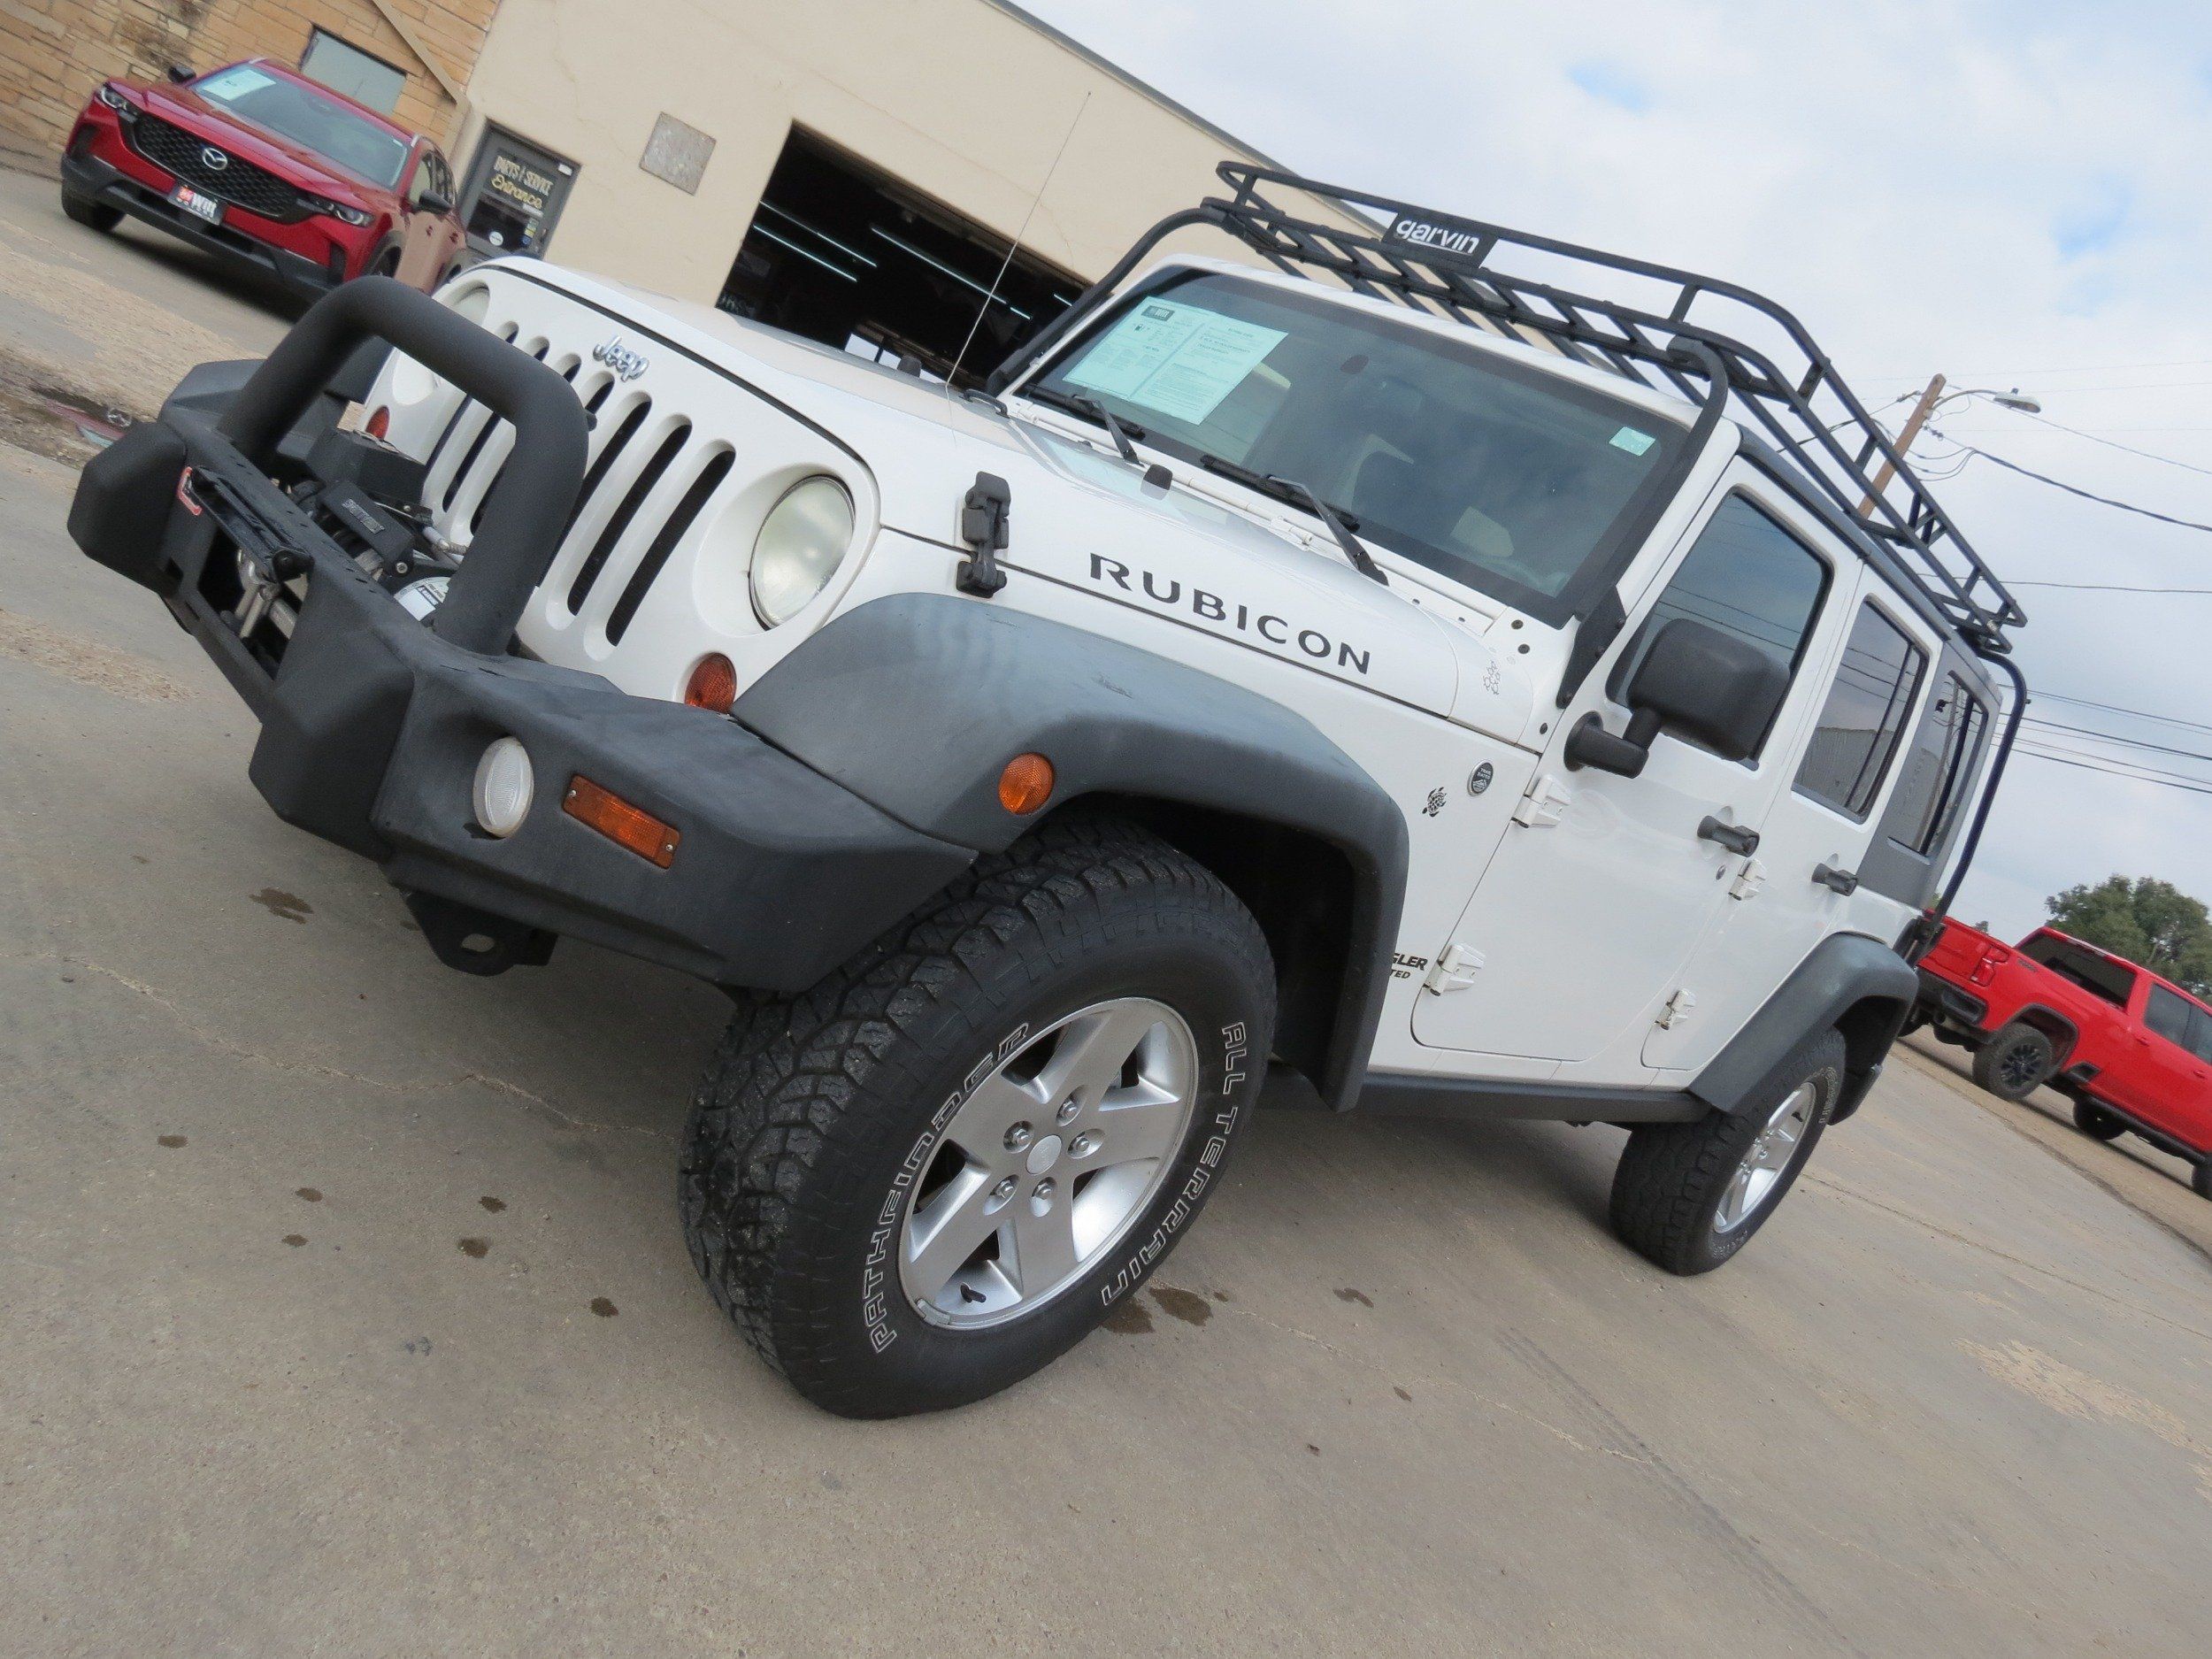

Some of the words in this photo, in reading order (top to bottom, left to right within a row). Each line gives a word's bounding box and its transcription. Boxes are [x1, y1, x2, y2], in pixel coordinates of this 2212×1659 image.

[1396, 219, 1480, 255] garvin
[592, 335, 650, 383] Jeep
[1090, 552, 1371, 675] RUBICON
[1221, 1021, 1248, 1095] ALL
[863, 1022, 1029, 1355] PATHFINDER
[1101, 1106, 1239, 1307] TERRAIN
